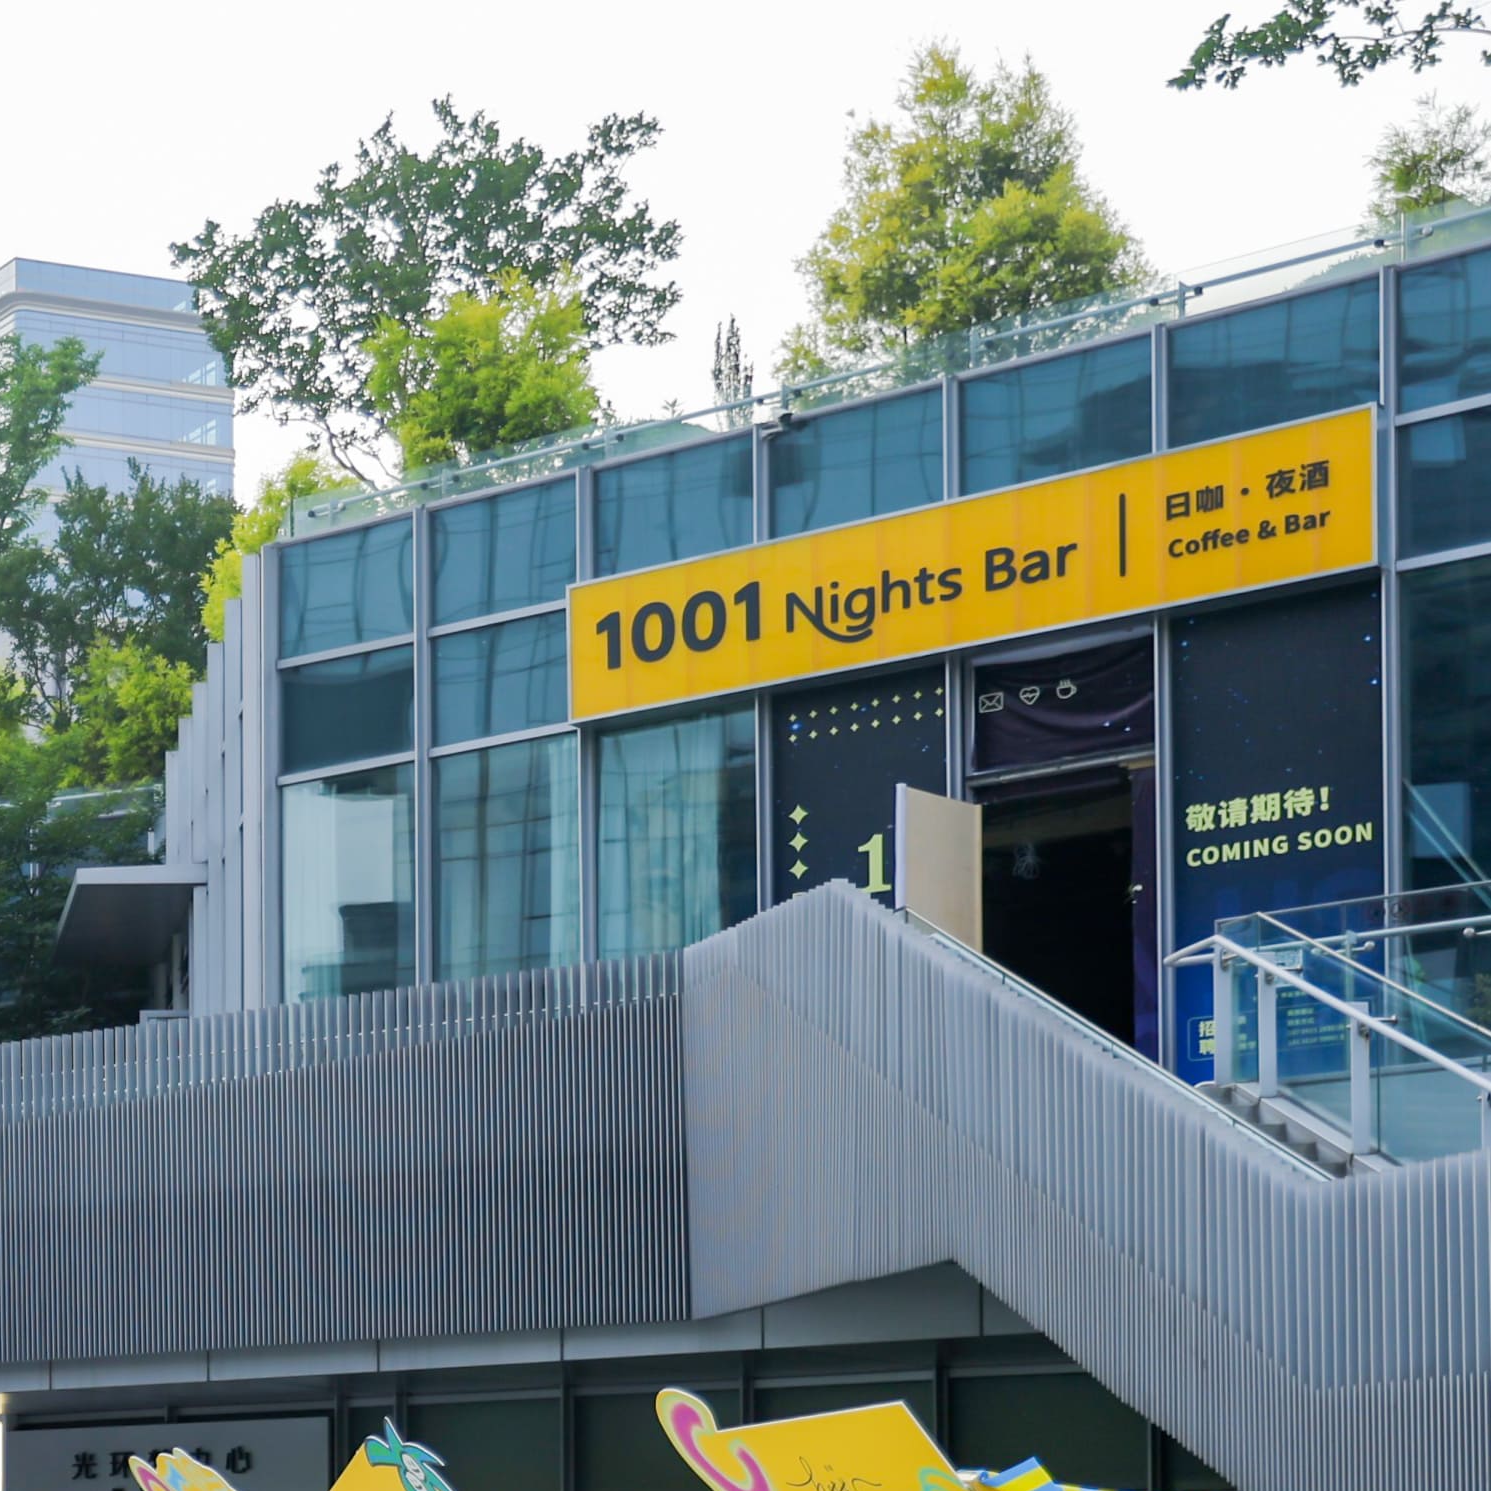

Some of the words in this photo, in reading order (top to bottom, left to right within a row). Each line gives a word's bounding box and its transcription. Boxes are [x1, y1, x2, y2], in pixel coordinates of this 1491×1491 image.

[1168, 524, 1250, 560] Coffee
[1257, 517, 1277, 542] &
[1283, 506, 1330, 538] Bar
[596, 579, 761, 670] 1001
[785, 566, 961, 642] Nights
[984, 541, 1077, 591] Bar
[1185, 831, 1289, 868] COMING
[1297, 820, 1374, 855] SOON
